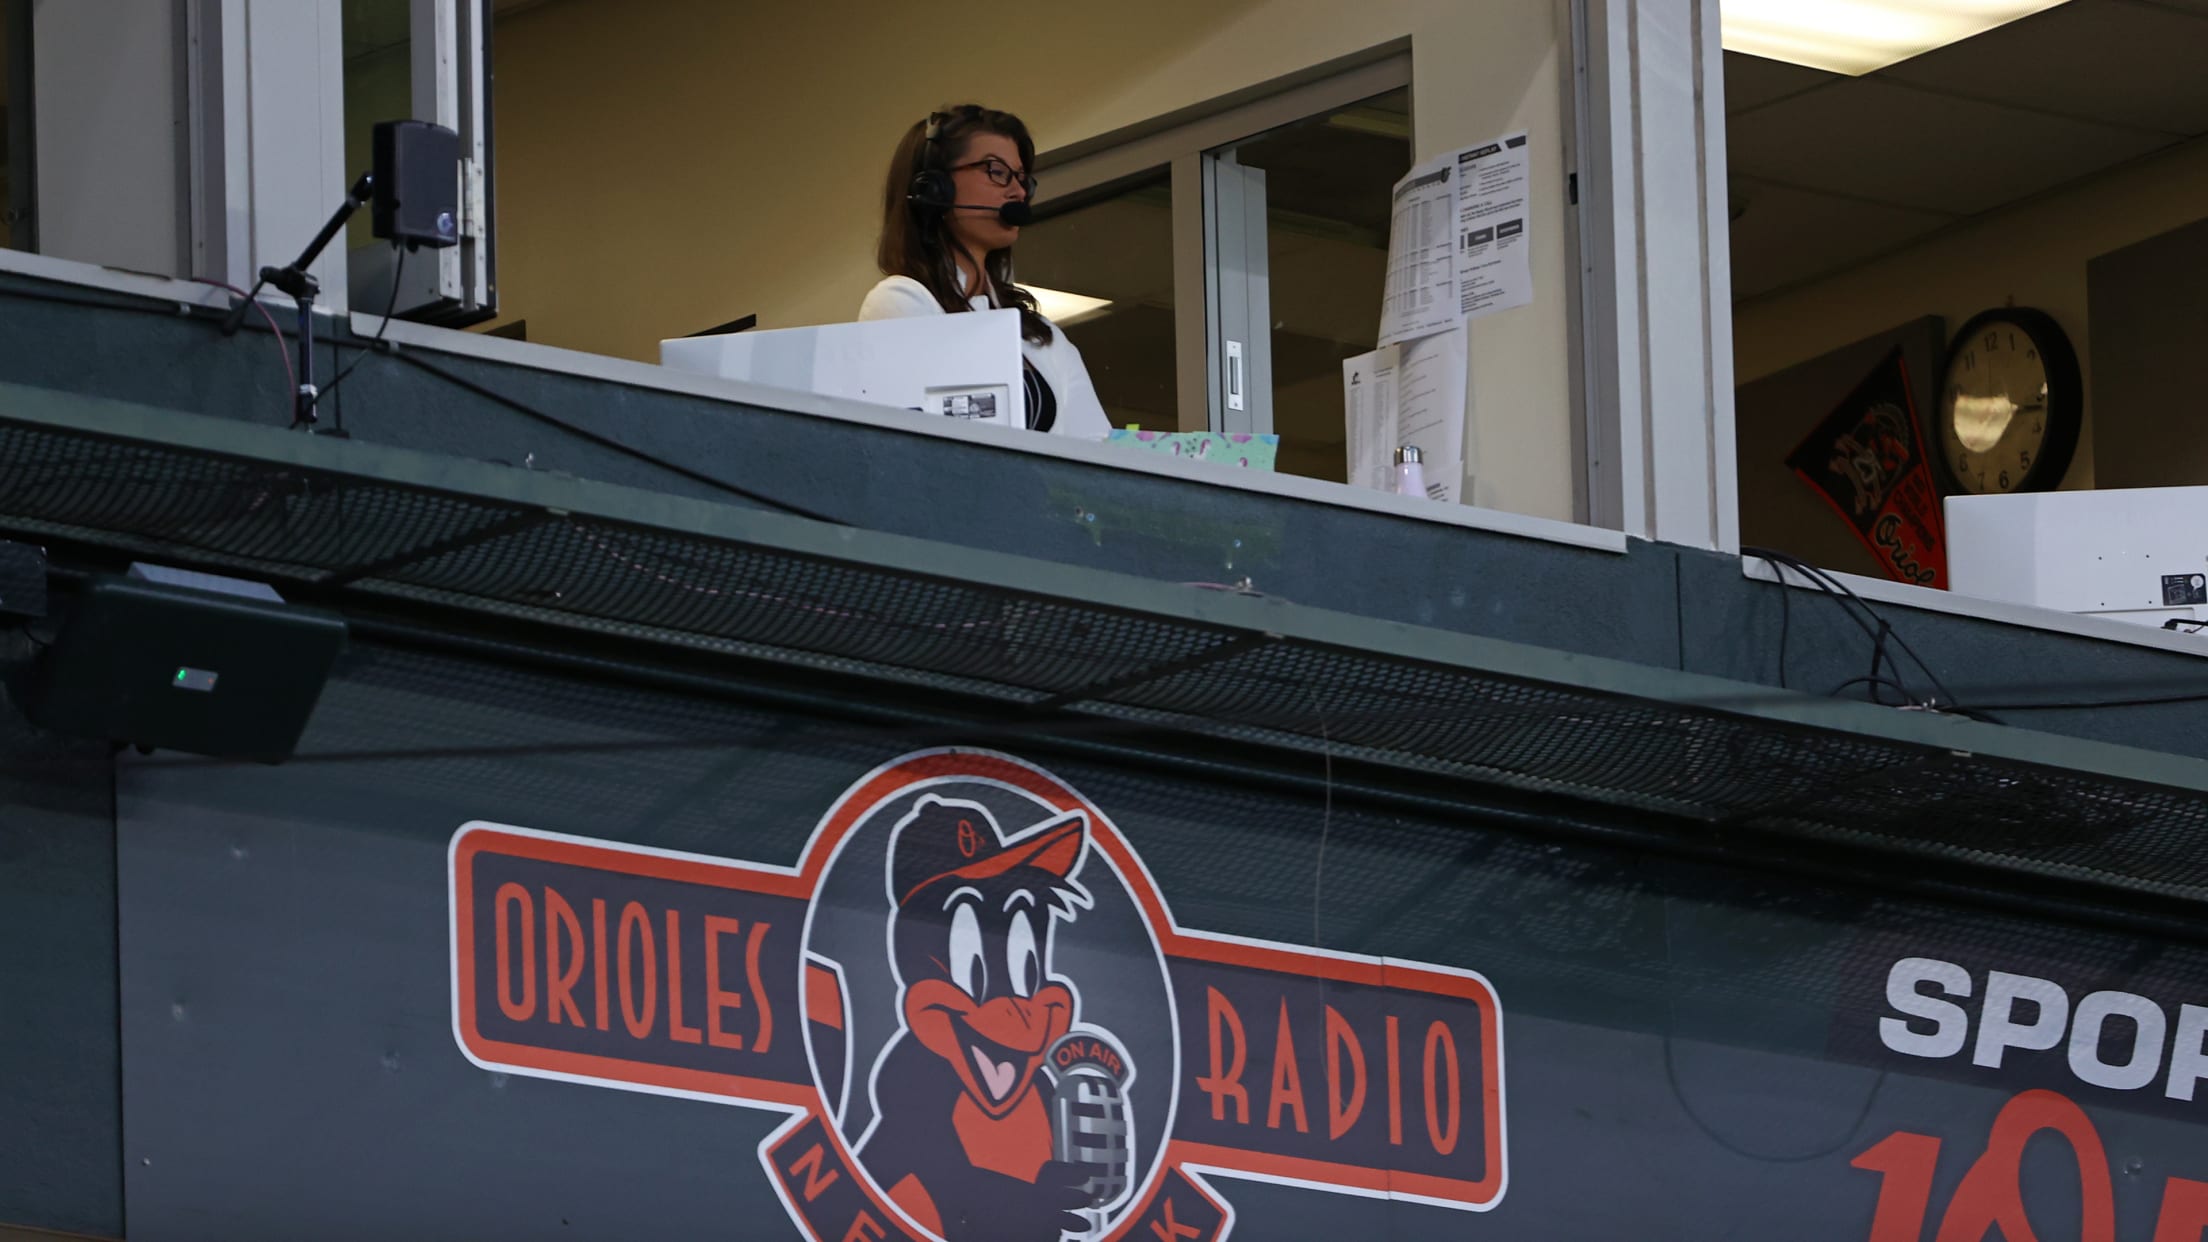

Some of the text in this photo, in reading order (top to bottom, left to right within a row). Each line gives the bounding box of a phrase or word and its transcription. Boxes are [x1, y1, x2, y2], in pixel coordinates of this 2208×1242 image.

[1984, 331, 1999, 352] 12
[2008, 333, 2016, 351] 1
[1964, 351, 1975, 371] 11
[2020, 451, 2031, 470] 5
[1977, 472, 1986, 491] 7
[1998, 470, 2009, 490] 6
[494, 881, 1460, 1156] ORIOLES RADIO
[1056, 1041, 1121, 1076] ON AIR
